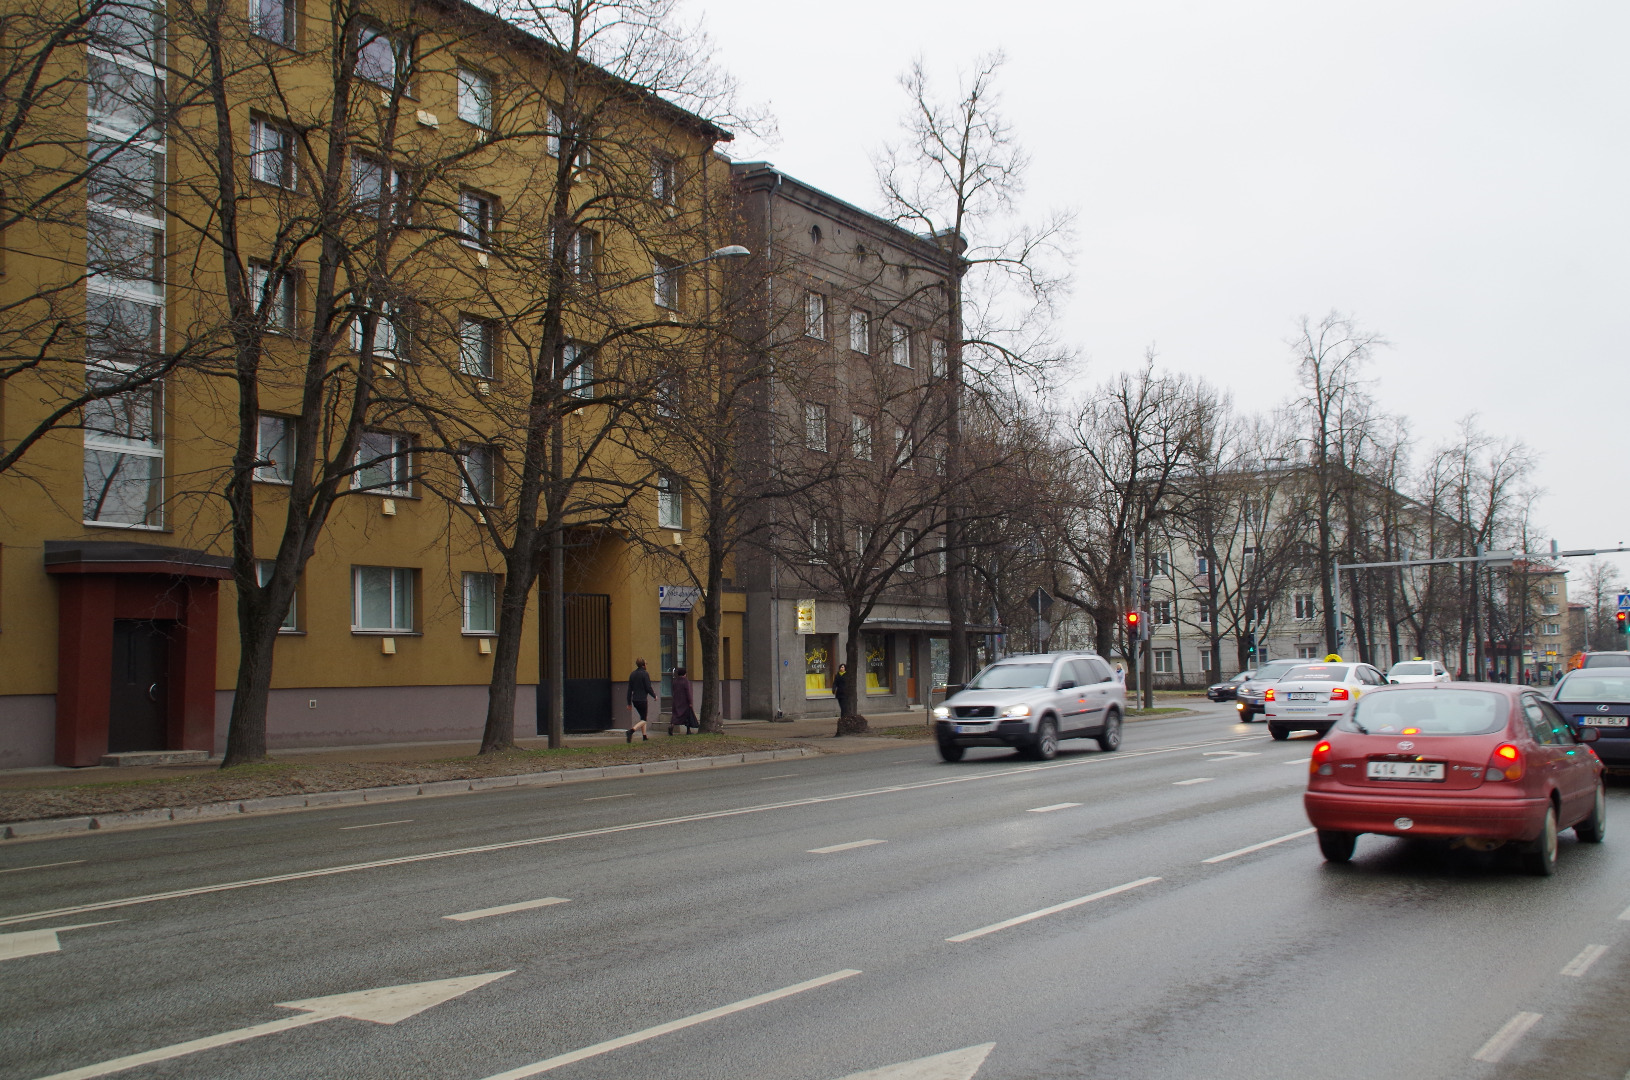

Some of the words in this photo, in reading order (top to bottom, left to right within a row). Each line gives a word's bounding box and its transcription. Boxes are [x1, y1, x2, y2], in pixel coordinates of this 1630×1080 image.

[1587, 717, 1602, 725] 014
[1607, 717, 1625, 725] BLK
[1373, 763, 1396, 776] 414
[1407, 764, 1437, 777] ANF
